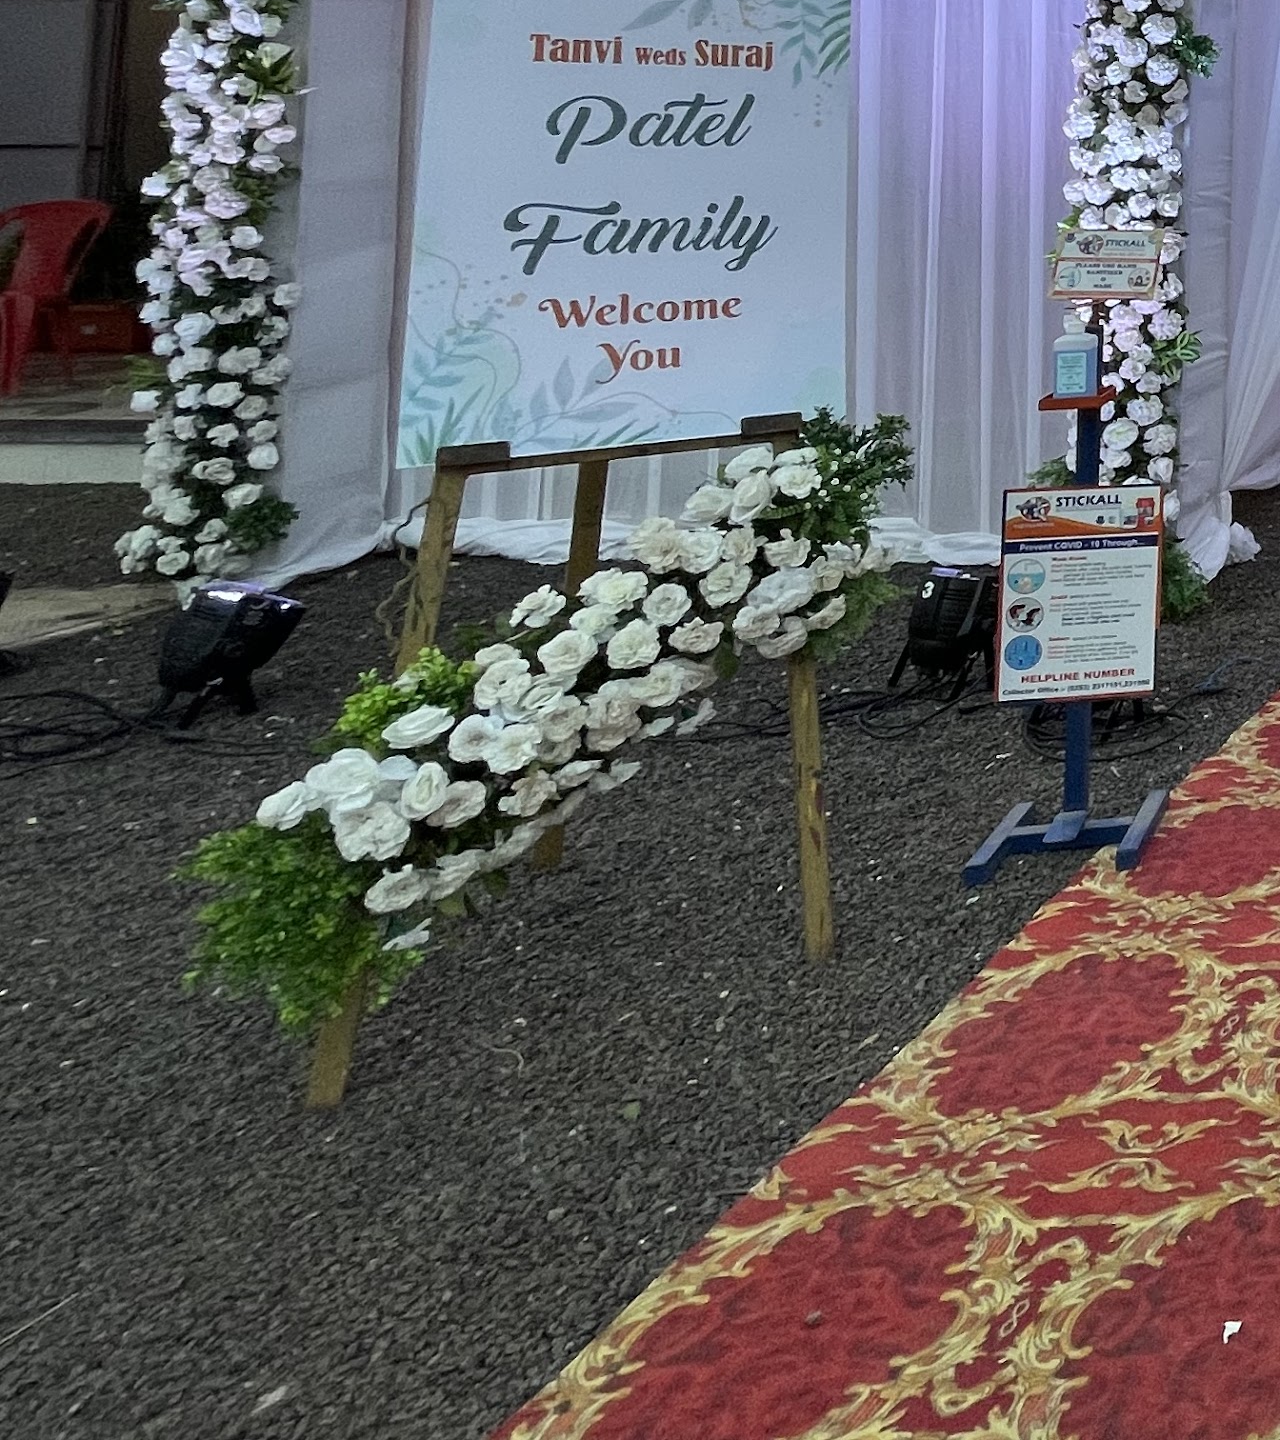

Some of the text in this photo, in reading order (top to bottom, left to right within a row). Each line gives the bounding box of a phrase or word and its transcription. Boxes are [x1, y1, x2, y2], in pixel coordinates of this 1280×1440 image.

[529, 33, 624, 65] Tanvi
[694, 39, 774, 72] Suraj
[546, 92, 756, 165] Patel
[502, 195, 779, 276] Family
[1105, 239, 1146, 248] STICKALL
[538, 293, 743, 329] Welcome
[595, 339, 682, 385] You
[1055, 494, 1122, 508] STICKALL
[1019, 542, 1053, 551] Prevent
[1053, 541, 1083, 550] COVID
[922, 581, 935, 599] 3
[1021, 668, 1135, 683] HELPLINE NUMBER
